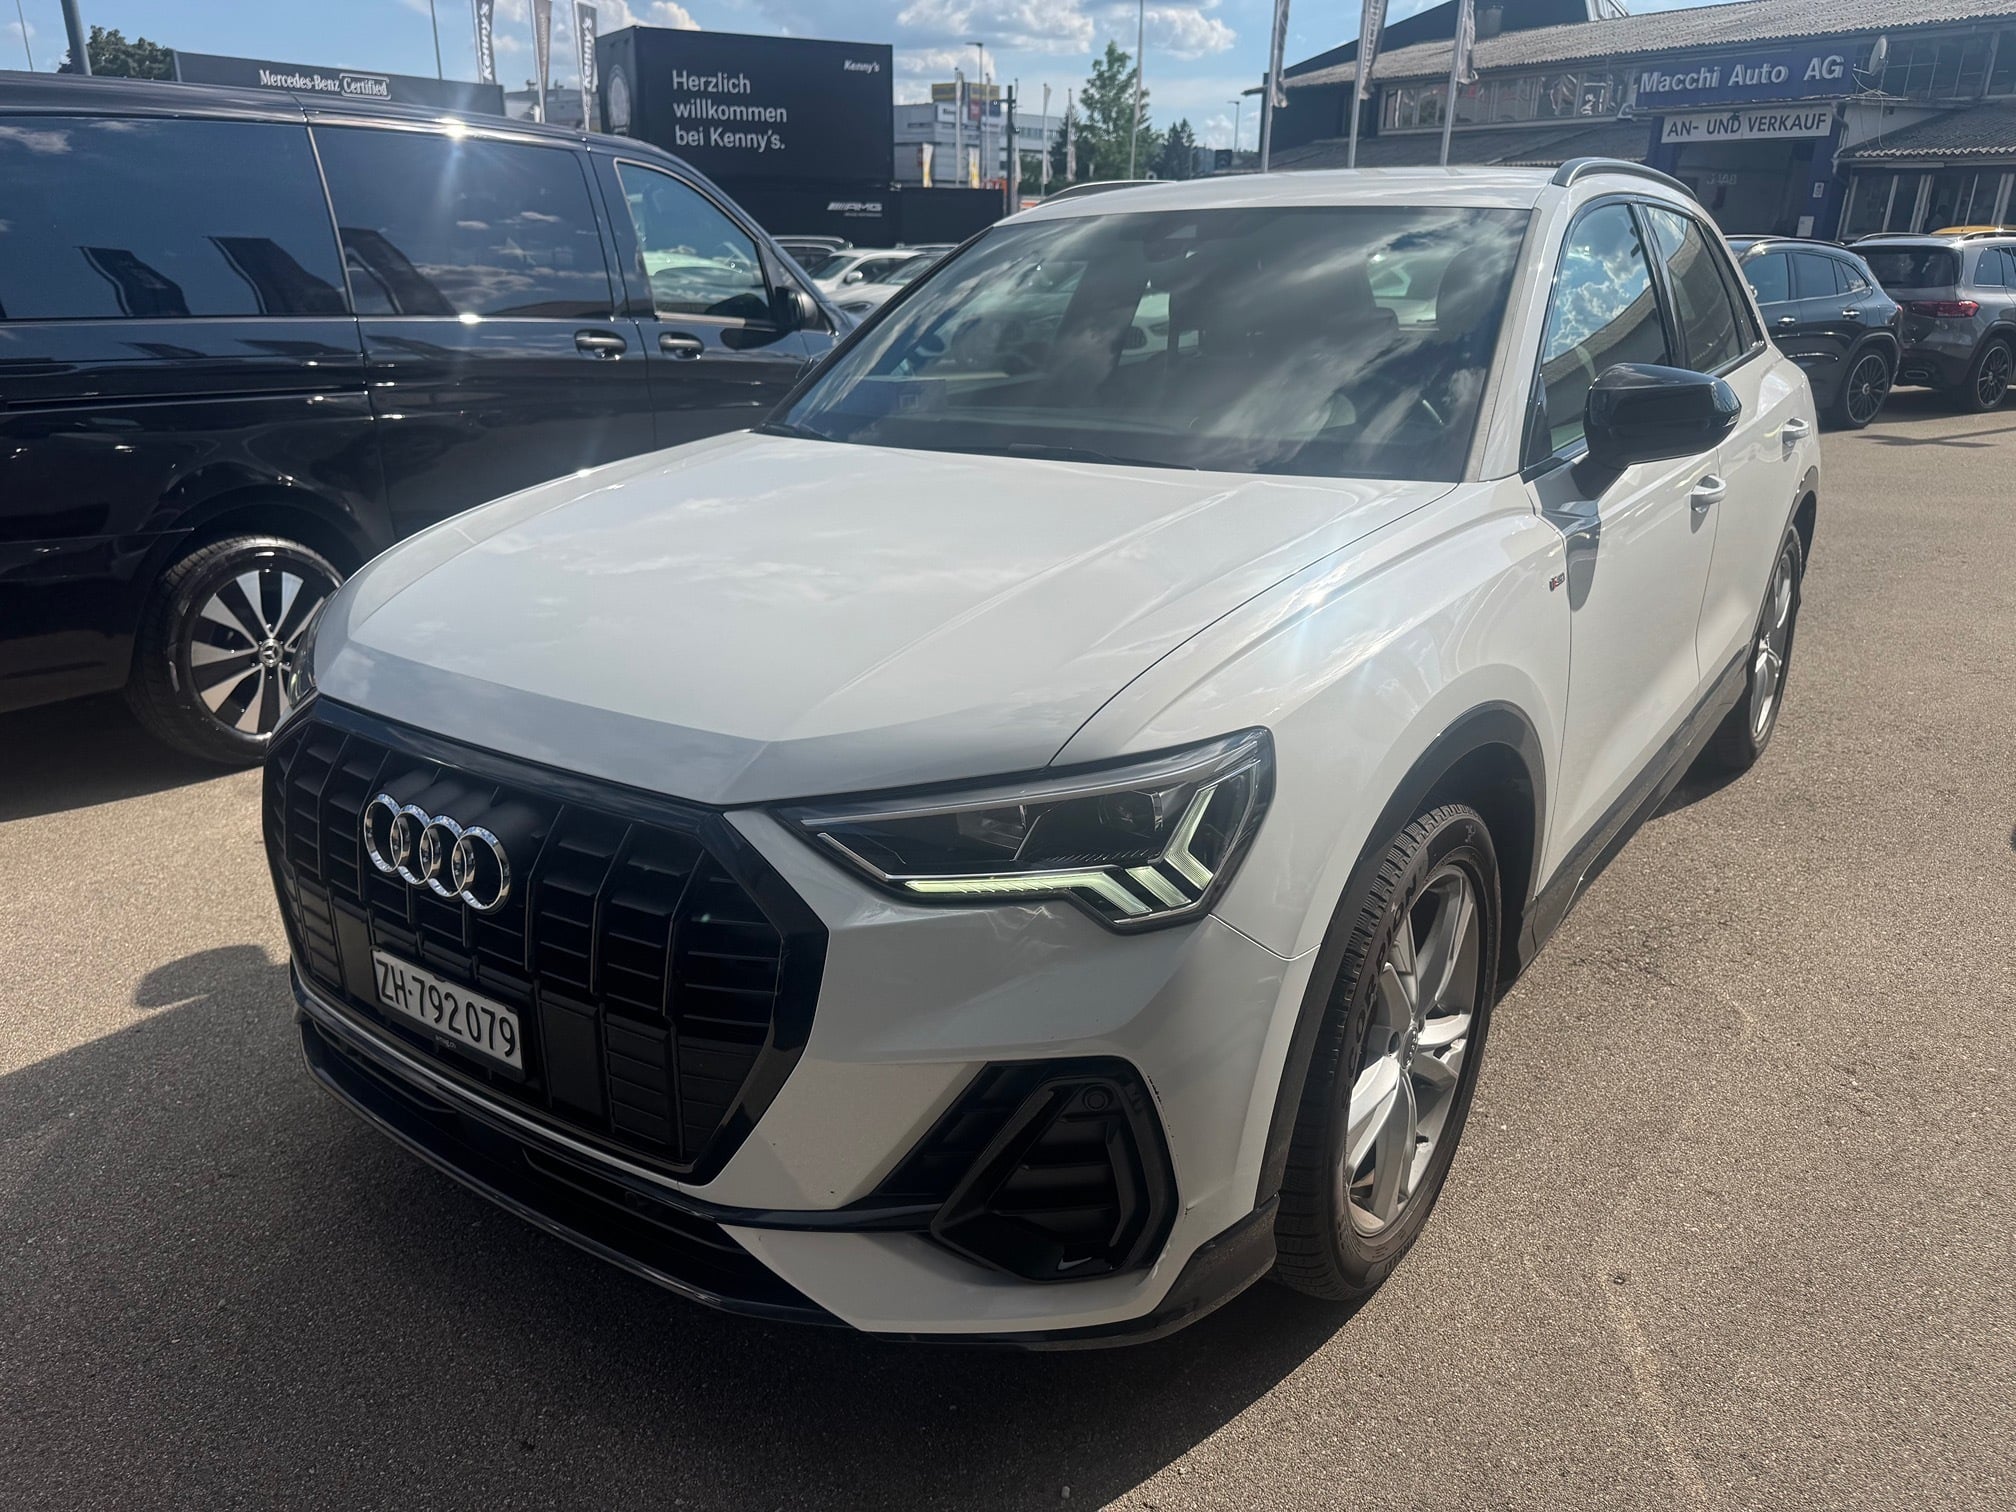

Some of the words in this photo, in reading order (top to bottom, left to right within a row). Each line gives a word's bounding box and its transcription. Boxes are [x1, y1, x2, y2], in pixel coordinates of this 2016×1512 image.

[843, 59, 880, 73] Kenny's
[1640, 66, 1722, 93] Macchi
[1728, 63, 1790, 87] Auto
[1803, 54, 1845, 81] AG
[259, 69, 341, 92] Mercedes-Benz
[343, 77, 388, 96] Certified
[672, 69, 751, 94] Herzlich
[673, 99, 788, 123] willkommen
[1667, 120, 1700, 138] AN-
[1706, 116, 1742, 134] UND
[1748, 112, 1827, 133] VERKAUF
[675, 125, 704, 146] bei
[710, 127, 786, 153] Kenny's.
